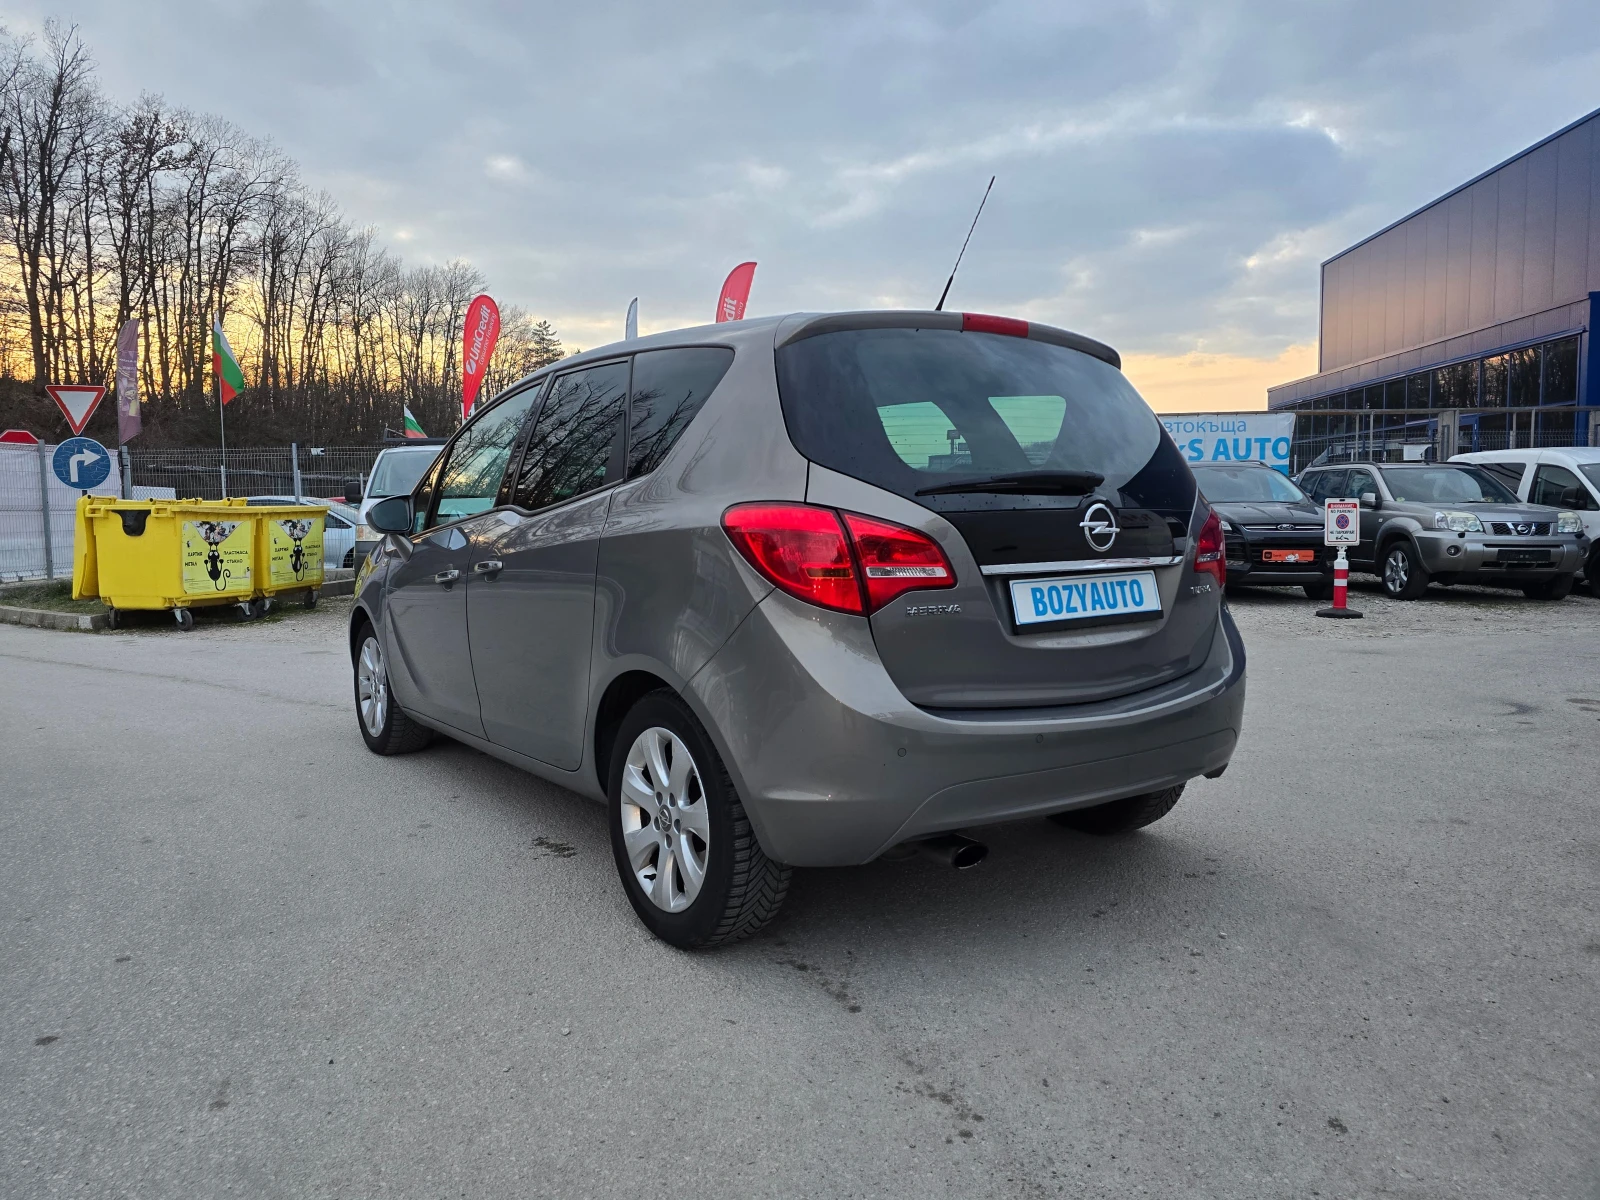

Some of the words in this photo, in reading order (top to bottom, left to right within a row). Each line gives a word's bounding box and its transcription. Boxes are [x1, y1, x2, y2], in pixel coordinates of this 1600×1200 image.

[470, 304, 491, 361] UniCredit
[1211, 437, 1290, 461] AUTO
[906, 604, 962, 616] MERIVA
[1030, 579, 1144, 617] BOZYAUTO
